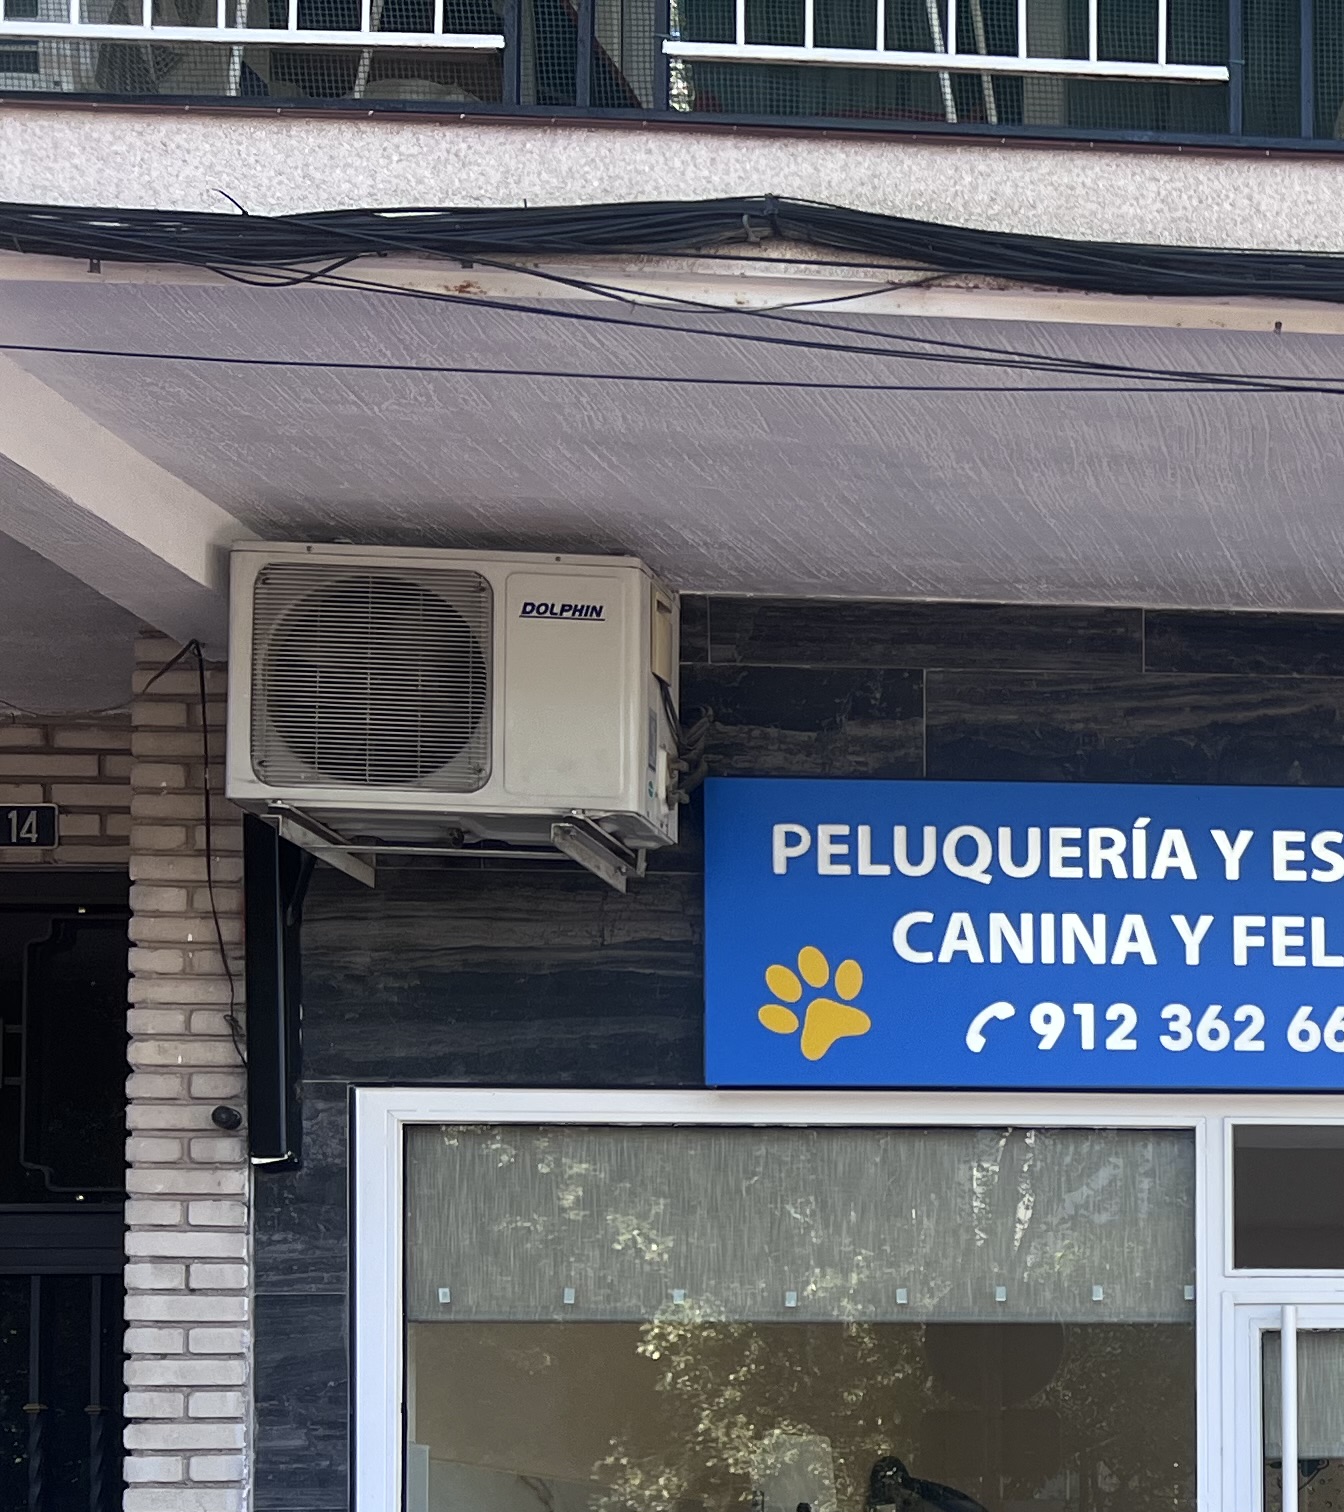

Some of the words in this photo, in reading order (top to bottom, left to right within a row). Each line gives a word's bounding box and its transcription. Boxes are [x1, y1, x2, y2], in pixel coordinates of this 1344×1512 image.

[521, 601, 604, 618] DOLPHIN
[7, 810, 38, 843] 14
[772, 816, 1198, 885] PELUQUERÍA
[1211, 829, 1252, 882] Y
[892, 910, 1158, 967] CANINA
[1173, 914, 1215, 967] Y
[1030, 1002, 1137, 1053] 912
[1158, 1003, 1265, 1053] 362
